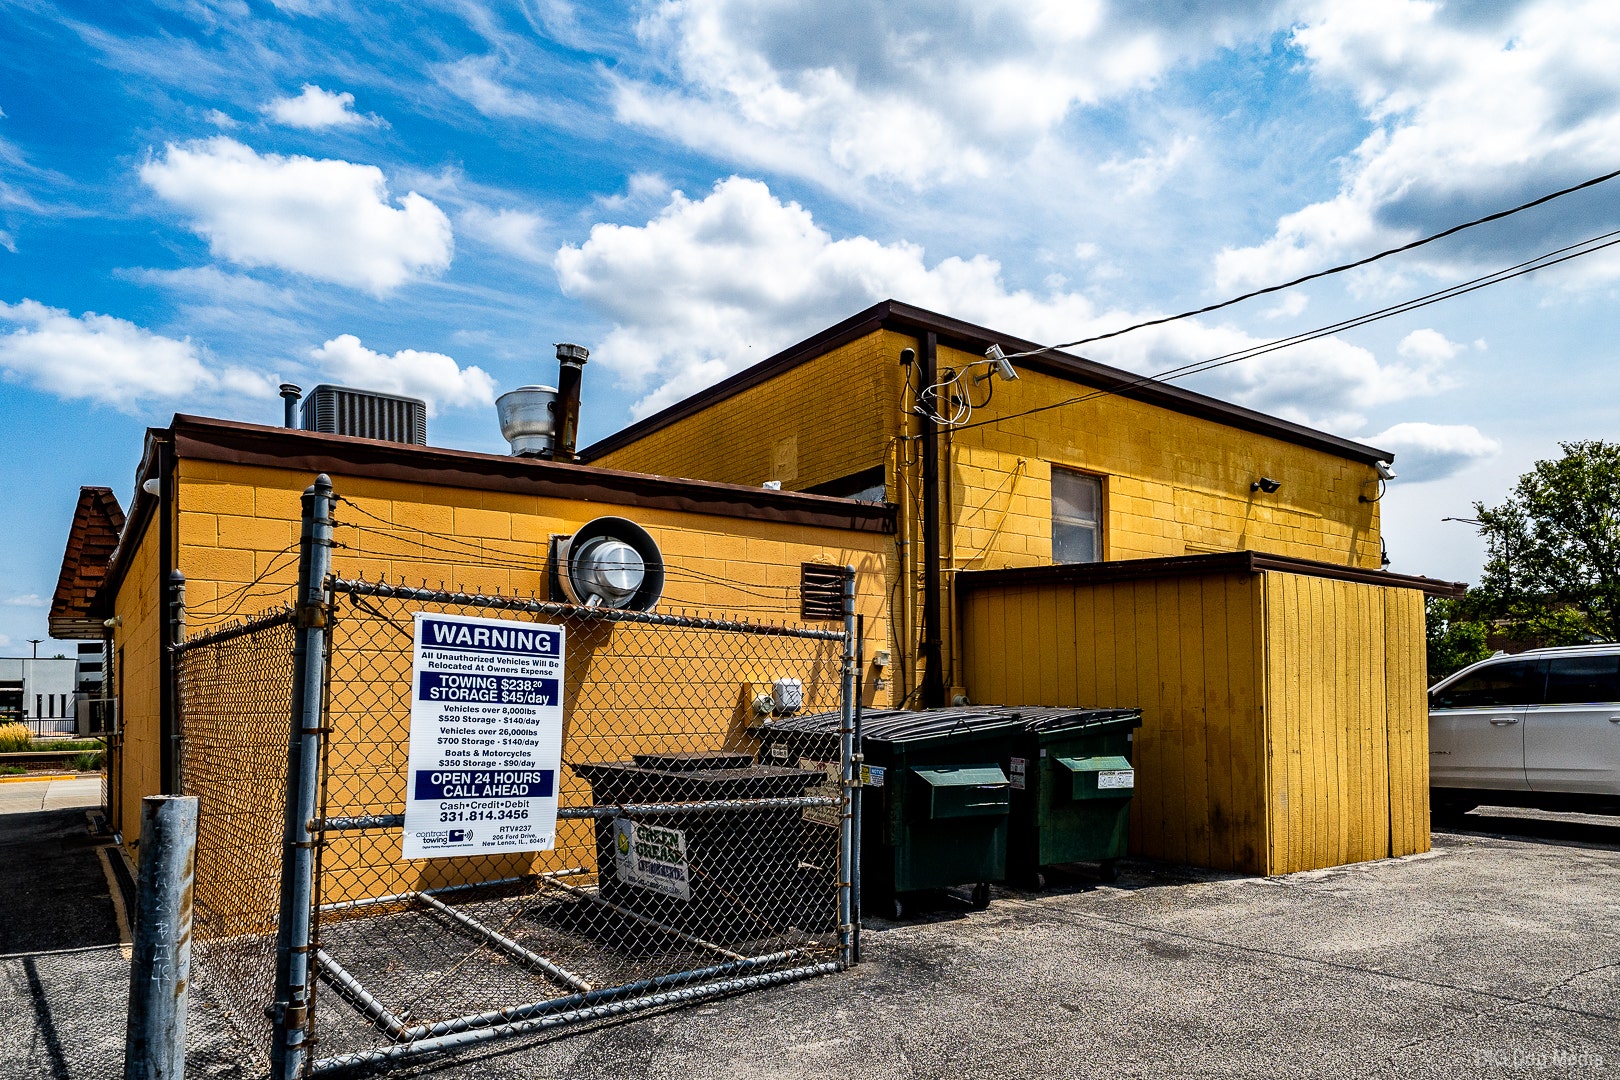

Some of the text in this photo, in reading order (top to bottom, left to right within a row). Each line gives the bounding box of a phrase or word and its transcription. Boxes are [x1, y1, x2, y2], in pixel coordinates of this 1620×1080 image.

[433, 624, 551, 652] WARNING
[436, 653, 495, 663] Unauthorized
[496, 657, 530, 666] Vehicles
[428, 662, 473, 670] Relocated
[487, 665, 518, 673] Owners
[520, 668, 553, 676] Expense
[439, 675, 497, 689] TOWING
[430, 688, 549, 705] STORAGE $45/day
[444, 705, 479, 713] Vehicles
[462, 716, 496, 724] Storage
[503, 717, 540, 725] $140/day
[498, 728, 538, 736] 26,000lbs
[461, 738, 495, 746] Storage
[502, 738, 539, 747] $140/day
[482, 750, 531, 759] Motorcycles
[463, 760, 496, 768] Storage
[431, 772, 541, 784] OPEN 24 HOURS
[443, 785, 529, 797] CALL AHEAD
[439, 810, 529, 822] 331.814.3456
[636, 827, 679, 846] GREEN
